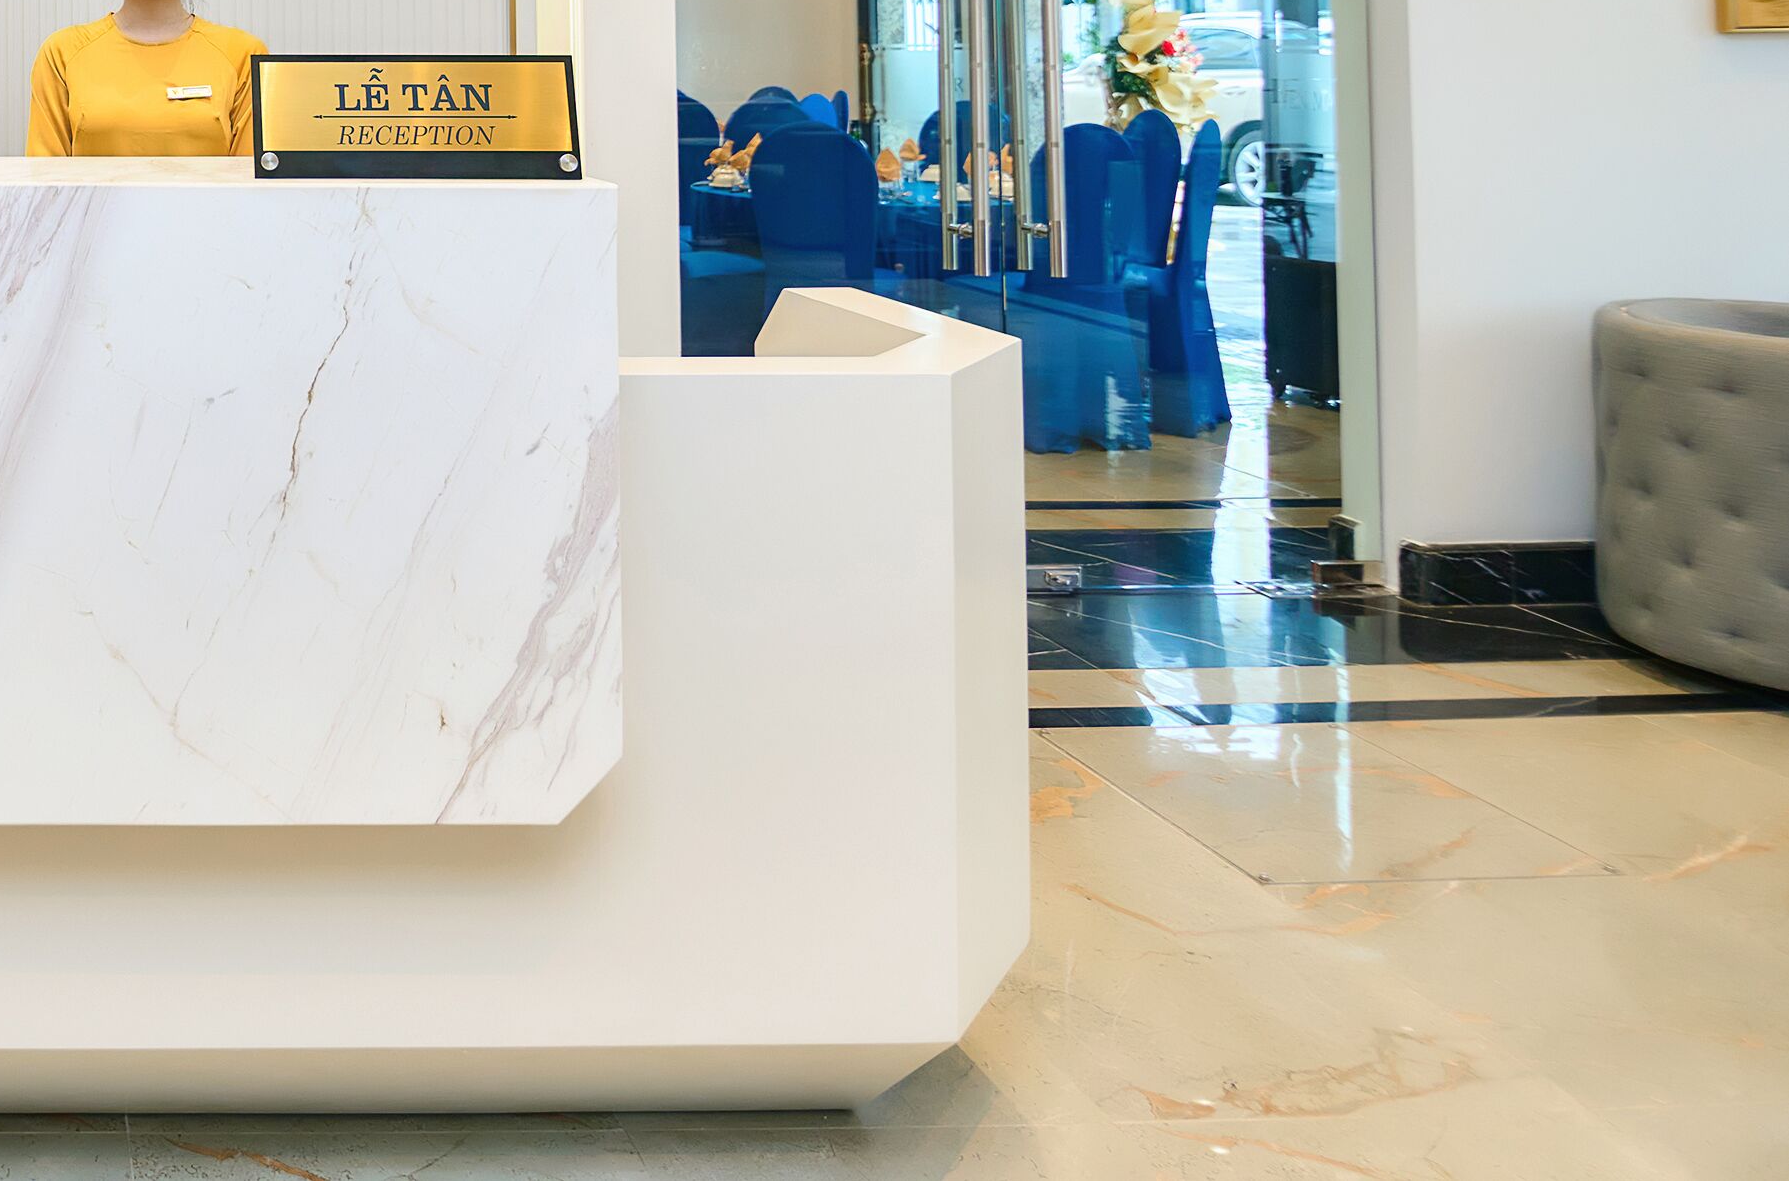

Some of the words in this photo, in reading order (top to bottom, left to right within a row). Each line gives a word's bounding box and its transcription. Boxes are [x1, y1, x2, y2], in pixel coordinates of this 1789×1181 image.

[334, 67, 390, 112] LỄ
[402, 74, 493, 112] TÂN
[336, 124, 497, 147] RECEPTION
